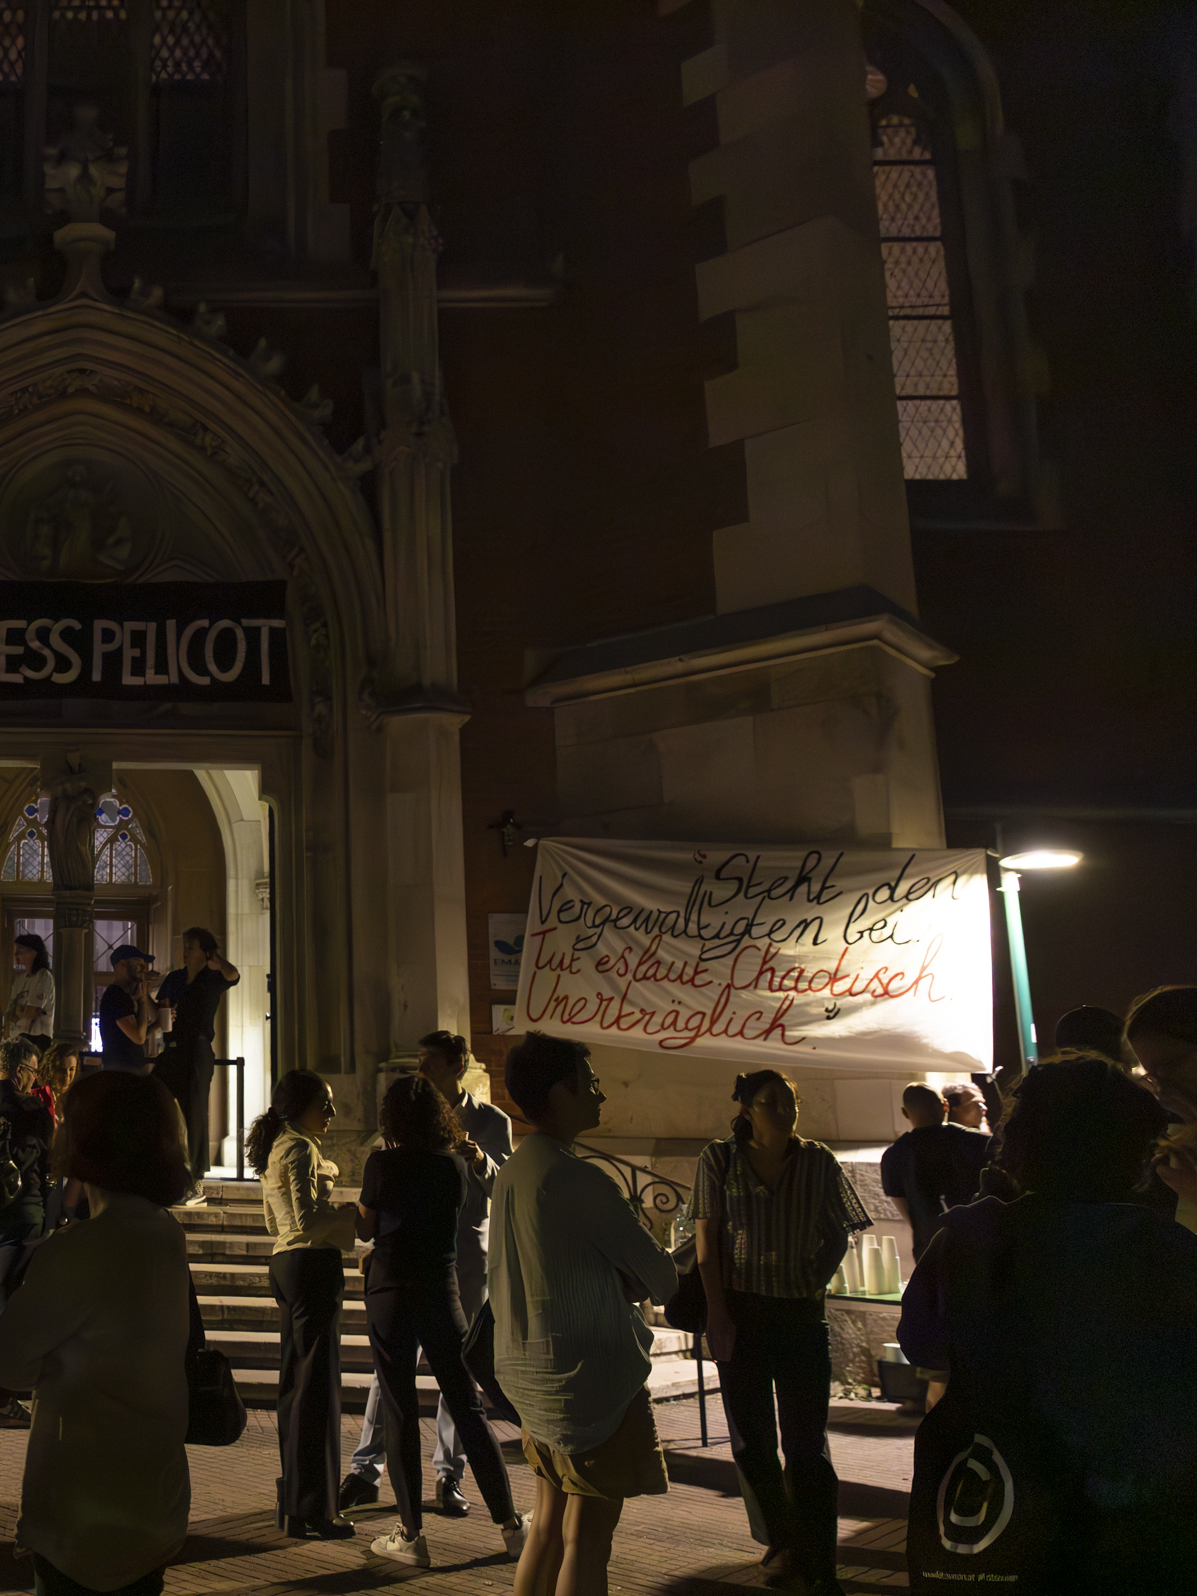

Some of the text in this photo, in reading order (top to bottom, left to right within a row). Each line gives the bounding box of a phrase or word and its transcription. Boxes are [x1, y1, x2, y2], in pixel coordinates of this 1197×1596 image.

[92, 618, 286, 685] PELICOT
[871, 853, 959, 904] den
[539, 872, 826, 962] Vergewaltigten
[531, 927, 581, 974] Tut
